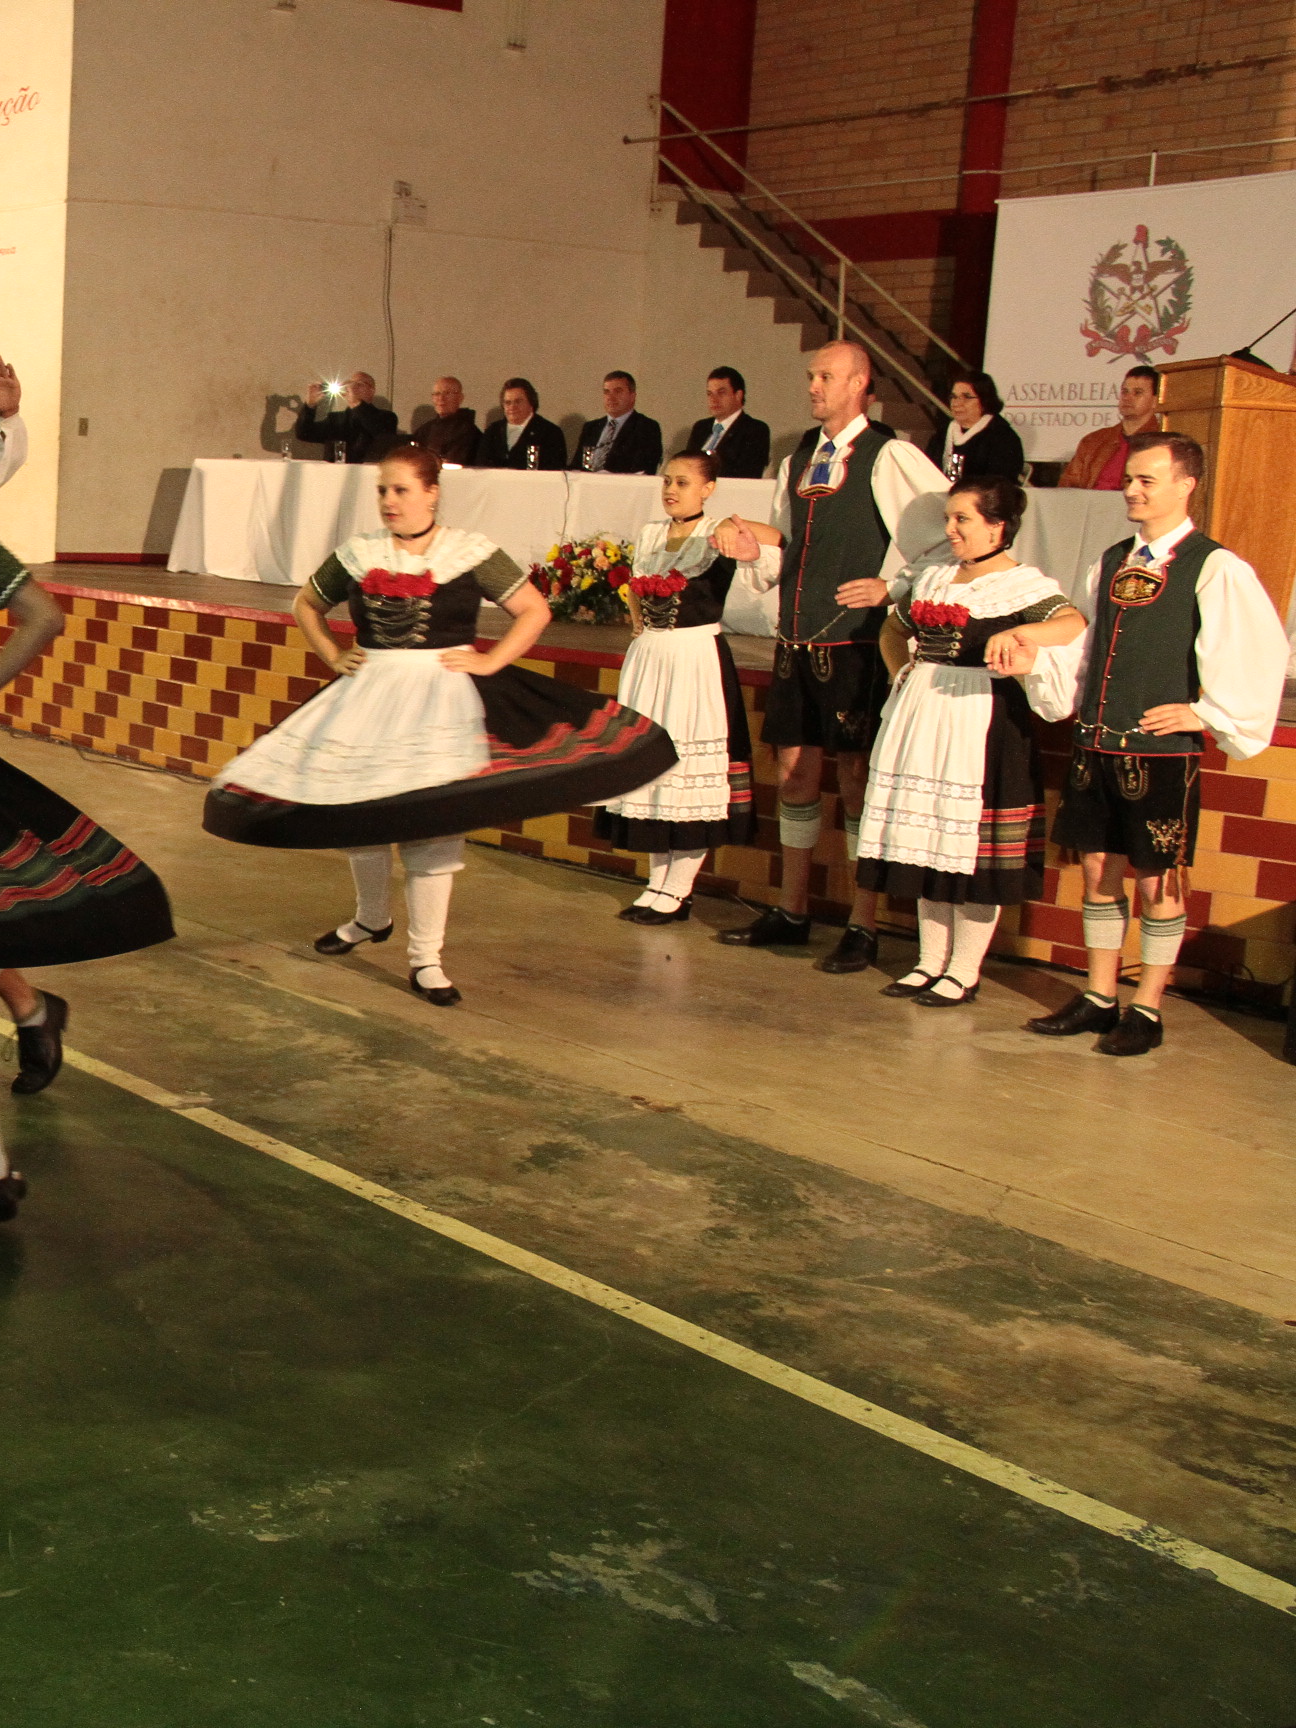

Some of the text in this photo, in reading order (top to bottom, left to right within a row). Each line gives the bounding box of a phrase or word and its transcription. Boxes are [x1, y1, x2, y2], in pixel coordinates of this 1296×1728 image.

[1007, 382, 1120, 401] ASSEMBLEIA
[1030, 411, 1087, 427] ESTADO
[1091, 412, 1112, 427] DE
